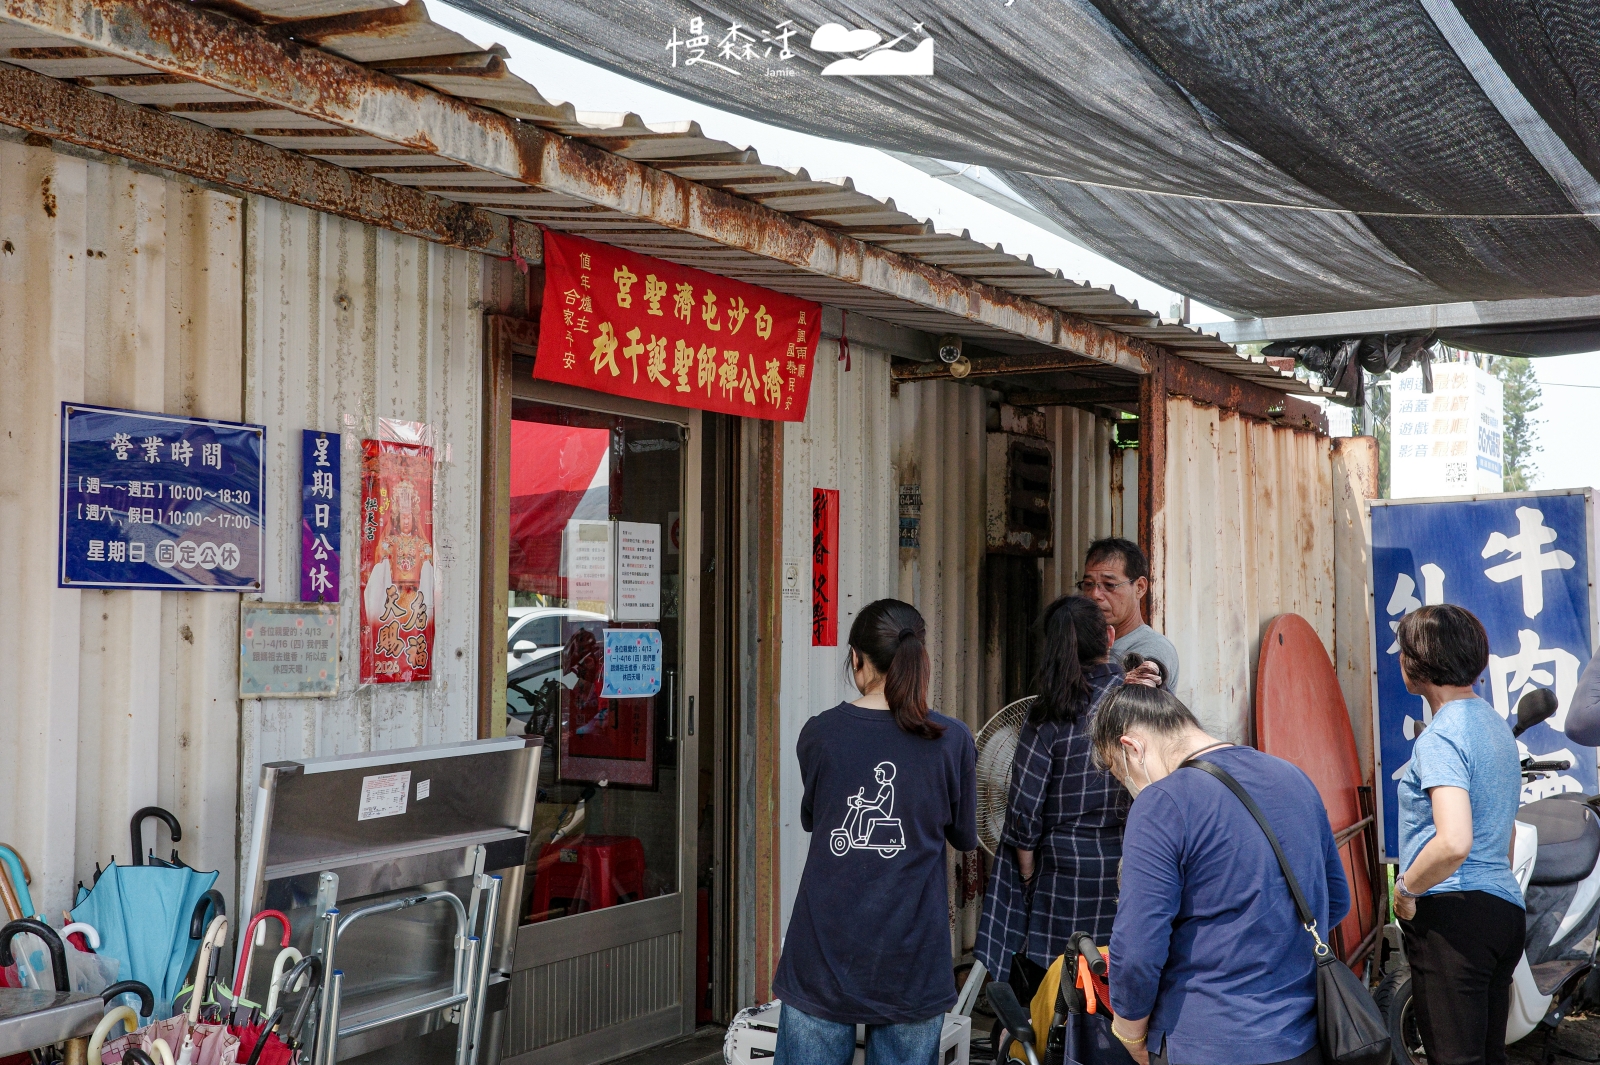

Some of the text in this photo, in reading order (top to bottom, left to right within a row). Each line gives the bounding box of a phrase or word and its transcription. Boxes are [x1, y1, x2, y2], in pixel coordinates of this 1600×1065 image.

[613, 265, 774, 341] 白沙屯濟聖宮
[110, 432, 223, 470] 營業時間
[308, 438, 334, 594] 星期日公休
[86, 540, 239, 568] 星期日 固定公休
[374, 661, 400, 674] 2026
